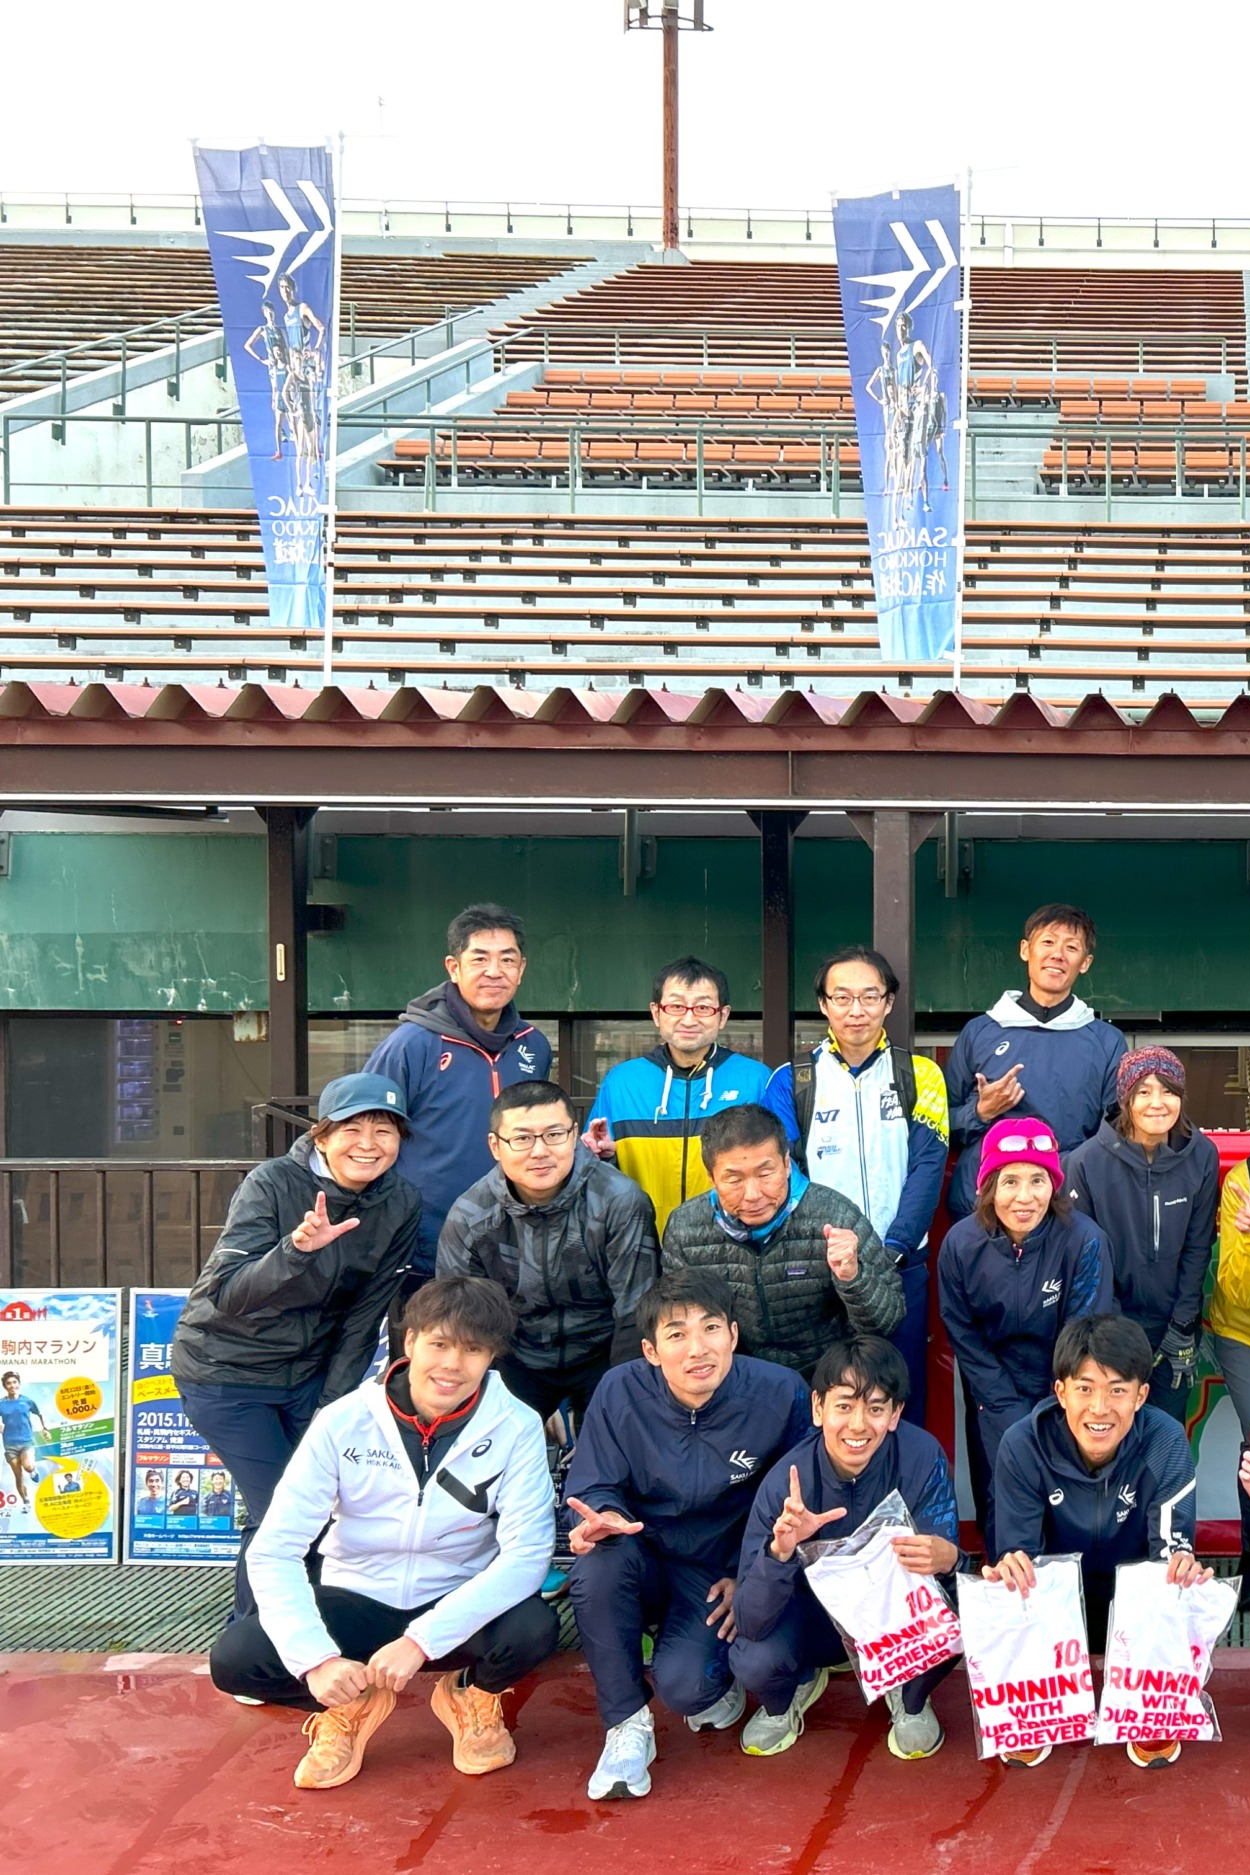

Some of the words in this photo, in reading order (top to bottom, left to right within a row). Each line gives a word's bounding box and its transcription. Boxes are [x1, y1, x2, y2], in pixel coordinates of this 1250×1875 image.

[1, 1339, 97, 1356] 駒内マラソン
[905, 1584, 934, 1619] 10
[883, 1624, 961, 1677] FRIENDS
[1053, 1639, 1081, 1669] 10
[1008, 1699, 1064, 1720] WITH
[1141, 1692, 1187, 1711] WITH
[994, 1723, 1088, 1750] FOREVER
[1115, 1724, 1200, 1741] FOREVER
